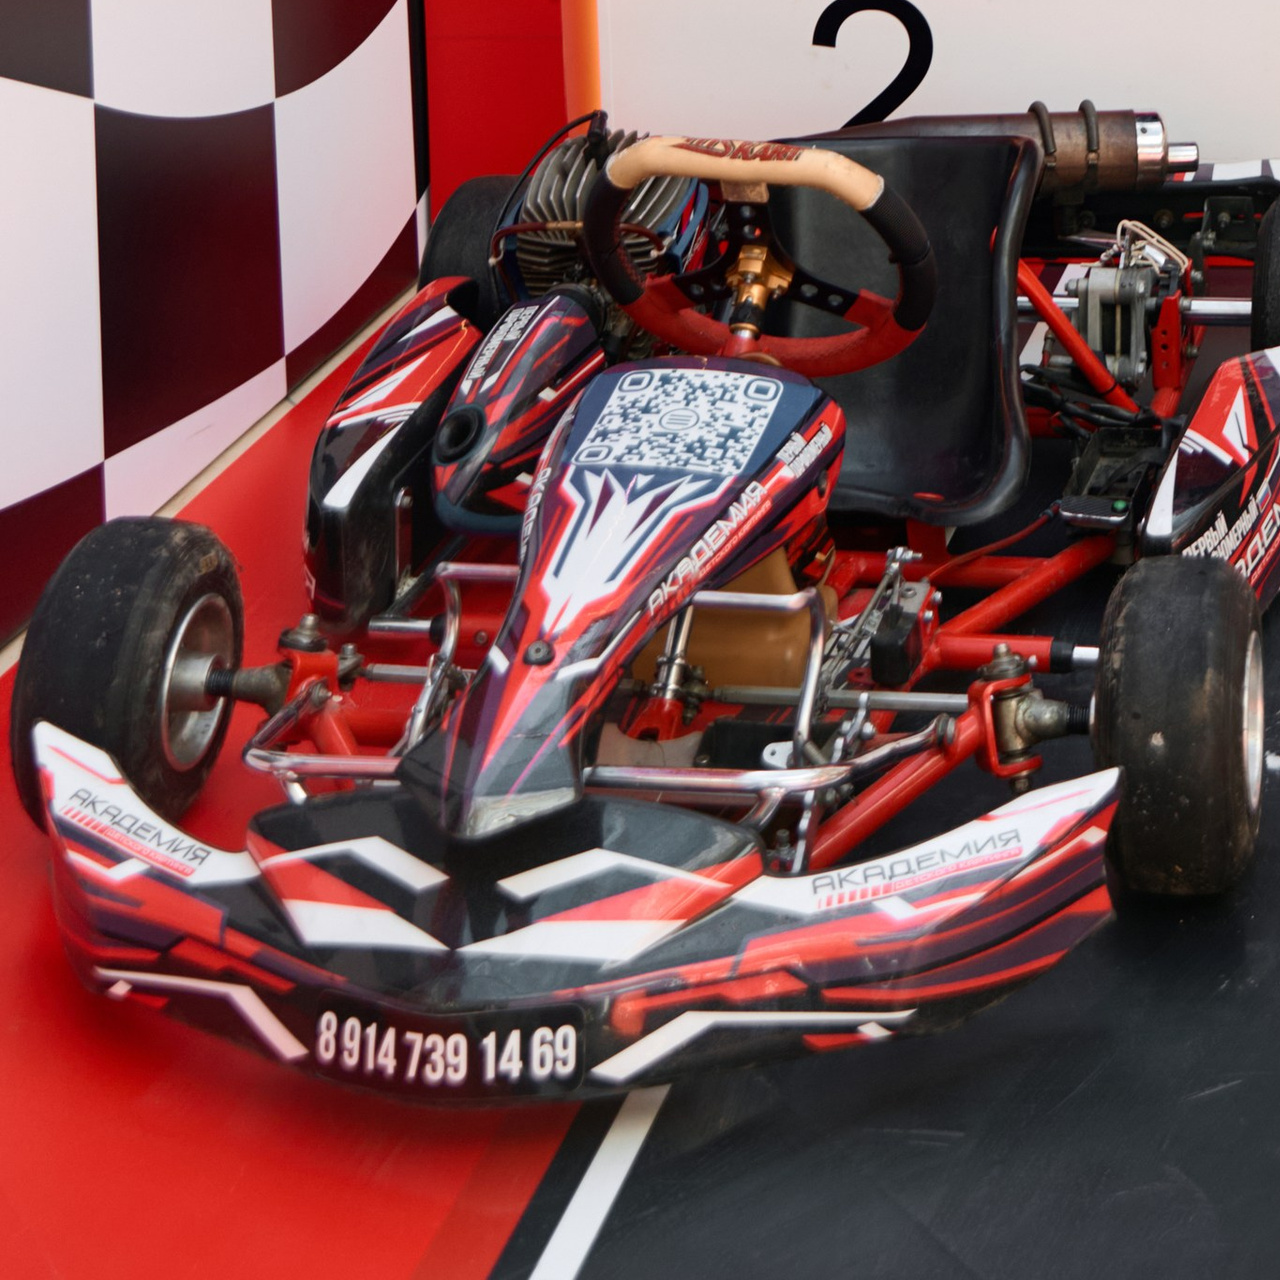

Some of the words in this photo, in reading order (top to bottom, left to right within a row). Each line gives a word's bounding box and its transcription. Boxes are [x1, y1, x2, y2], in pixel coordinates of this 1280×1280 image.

[648, 480, 768, 616] АКАДЕМИЯ
[69, 787, 213, 866] АКАДЕМИЯ
[811, 828, 1022, 894] АКАДЕМИЯ
[404, 1031, 468, 1081] 739
[481, 1028, 523, 1080] 14
[531, 1024, 577, 1076] 69
